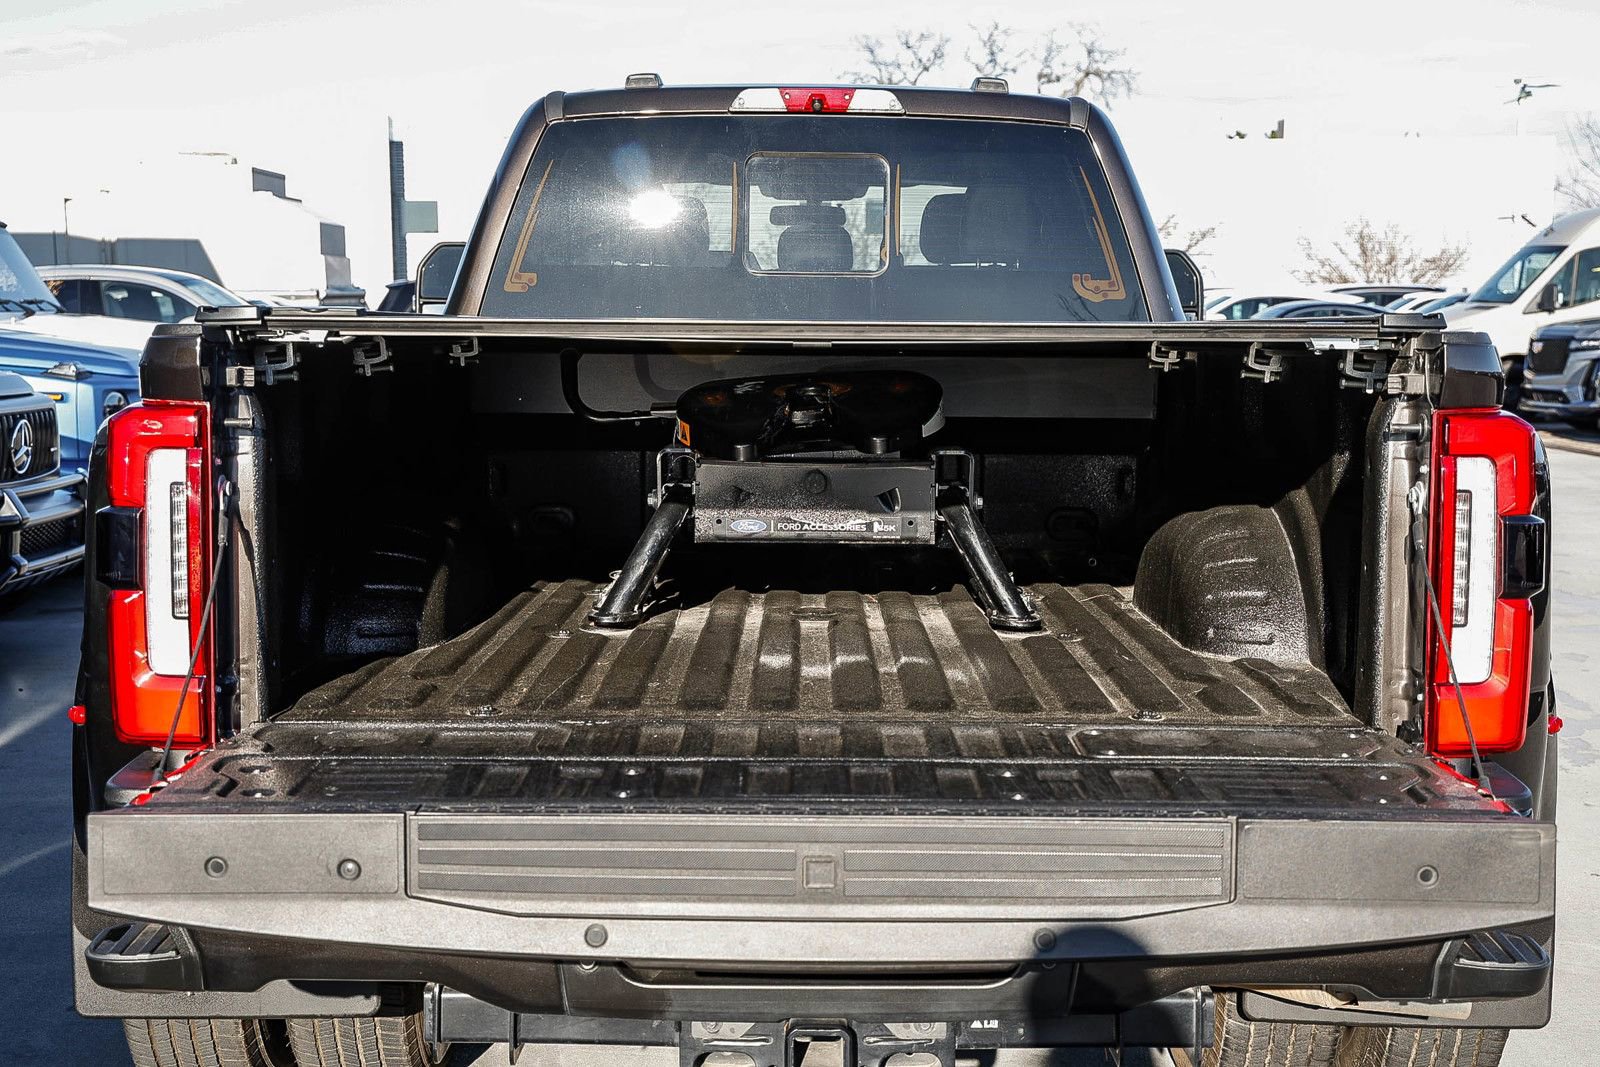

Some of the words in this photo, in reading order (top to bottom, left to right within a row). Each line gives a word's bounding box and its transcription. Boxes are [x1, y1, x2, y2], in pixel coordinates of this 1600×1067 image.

[737, 521, 760, 531] Ford
[777, 522, 801, 531] FORD
[802, 523, 867, 532] ACCESSORIES
